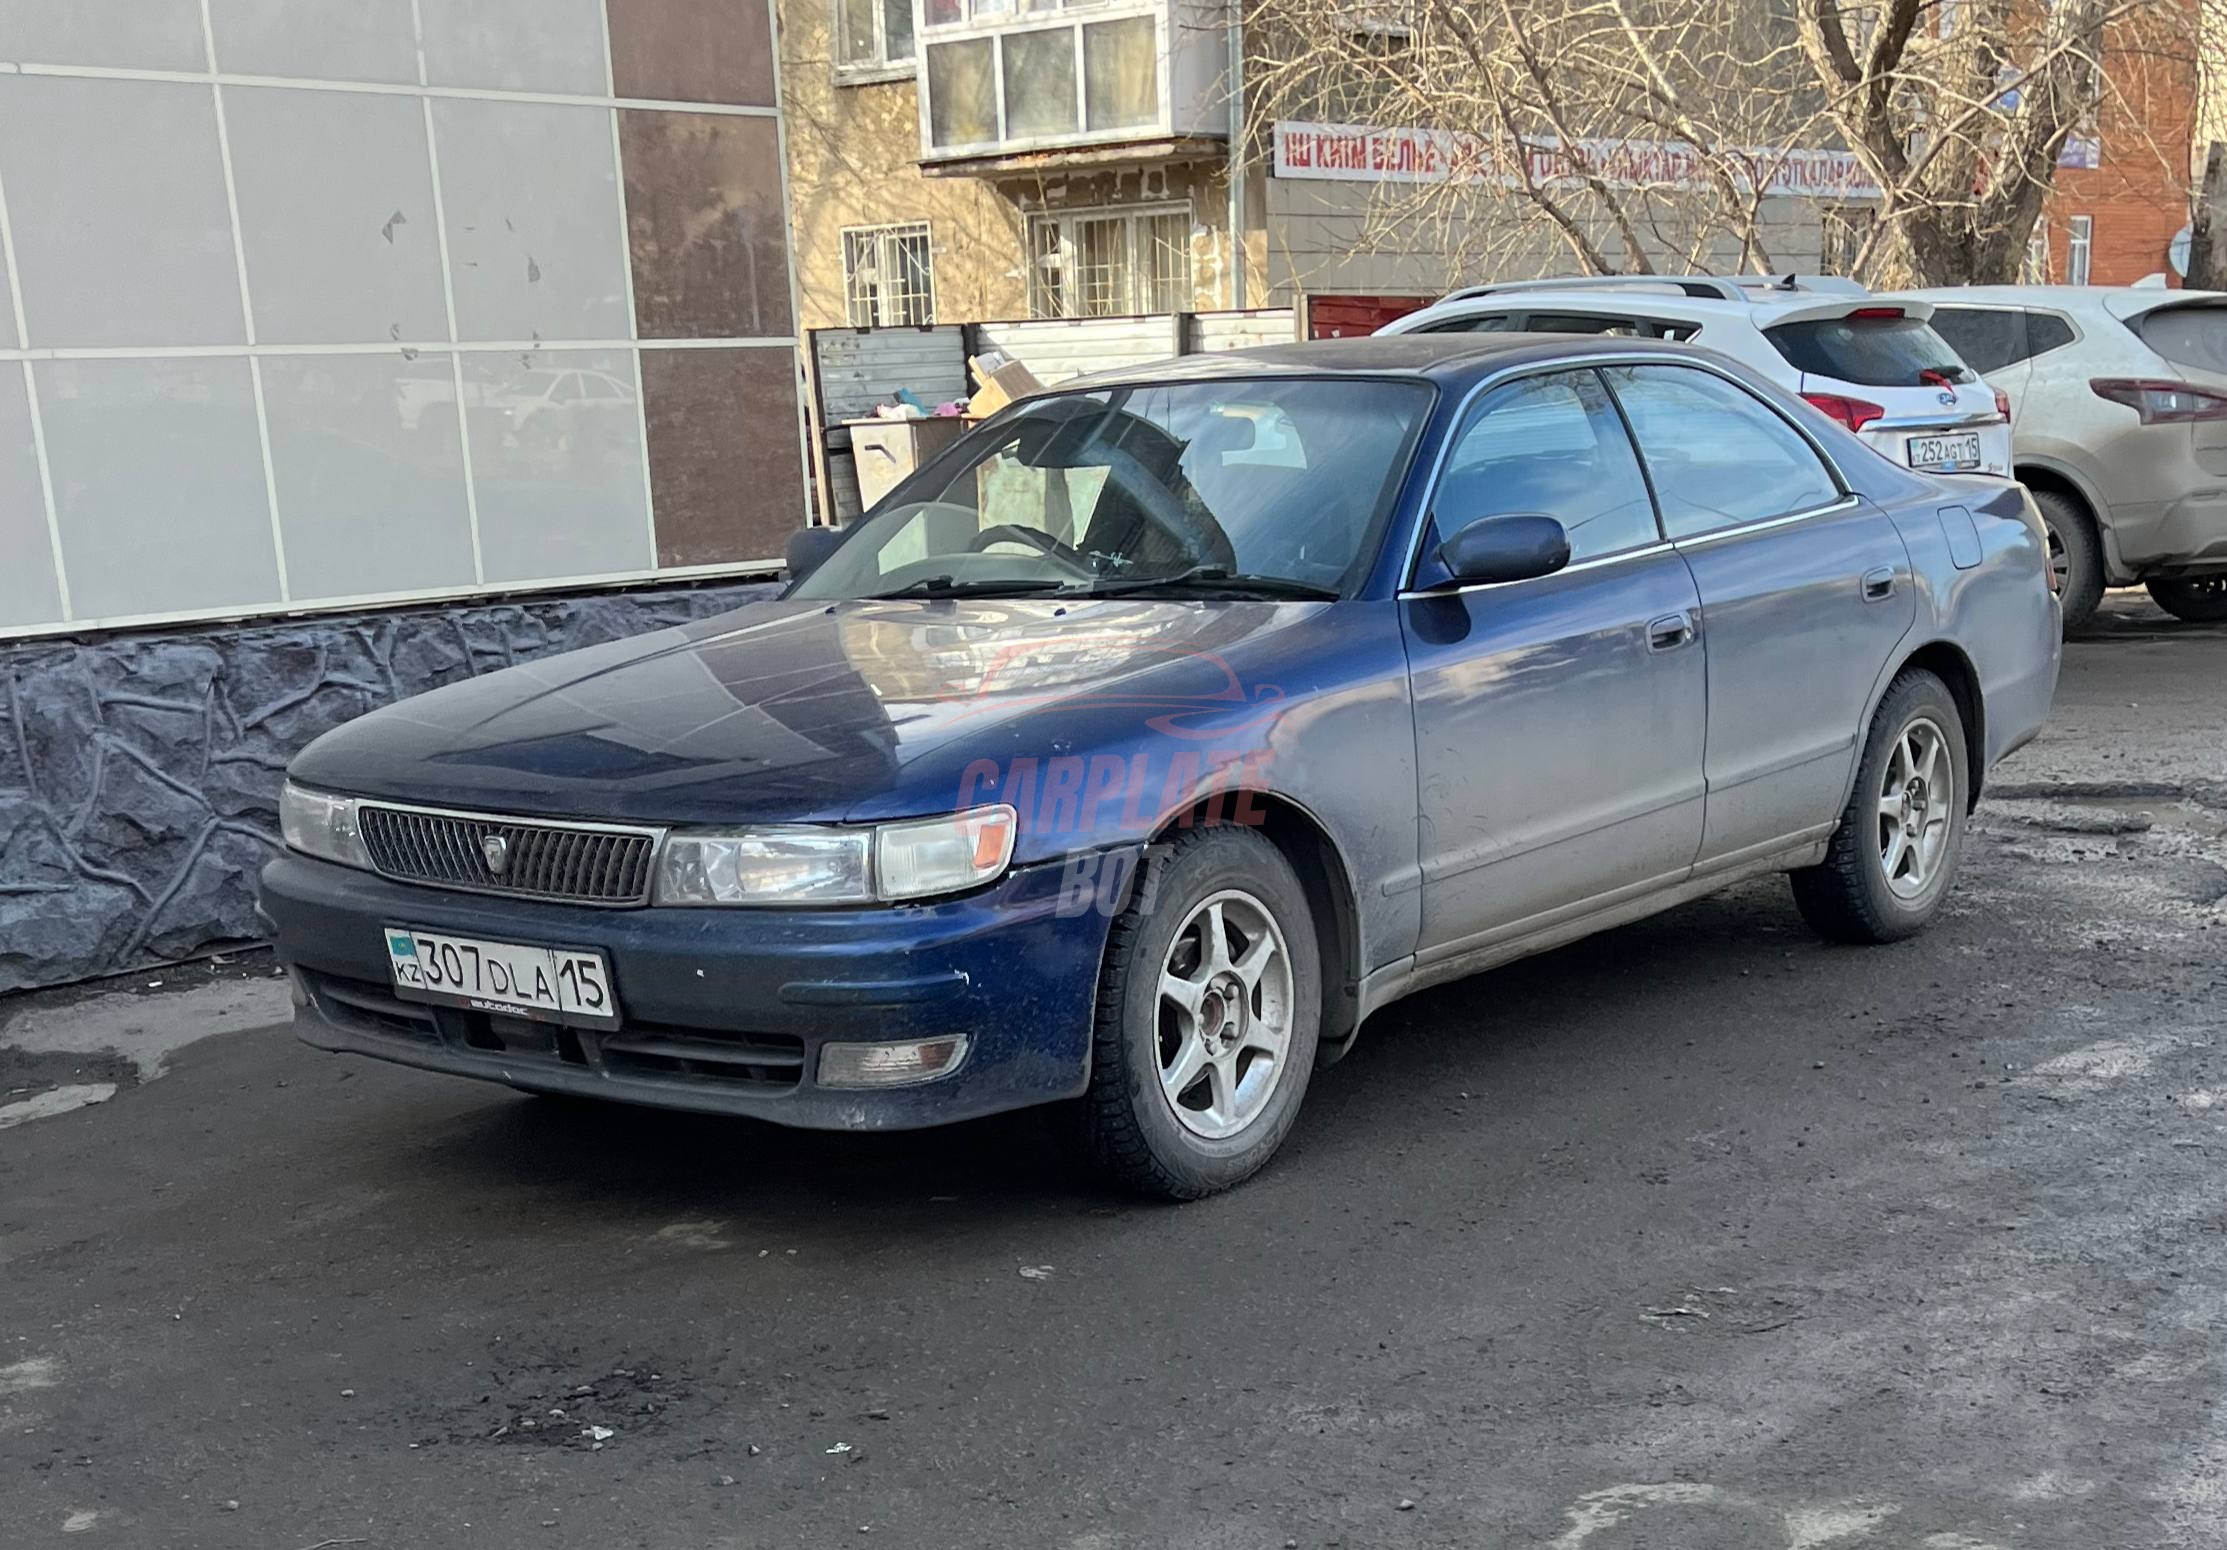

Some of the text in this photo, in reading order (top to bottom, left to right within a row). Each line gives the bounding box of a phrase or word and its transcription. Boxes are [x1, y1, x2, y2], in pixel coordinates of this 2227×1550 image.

[1921, 438, 1977, 462] 252 AGT 15
[396, 961, 422, 983] KZ
[417, 939, 603, 1008] 307 DLA 15
